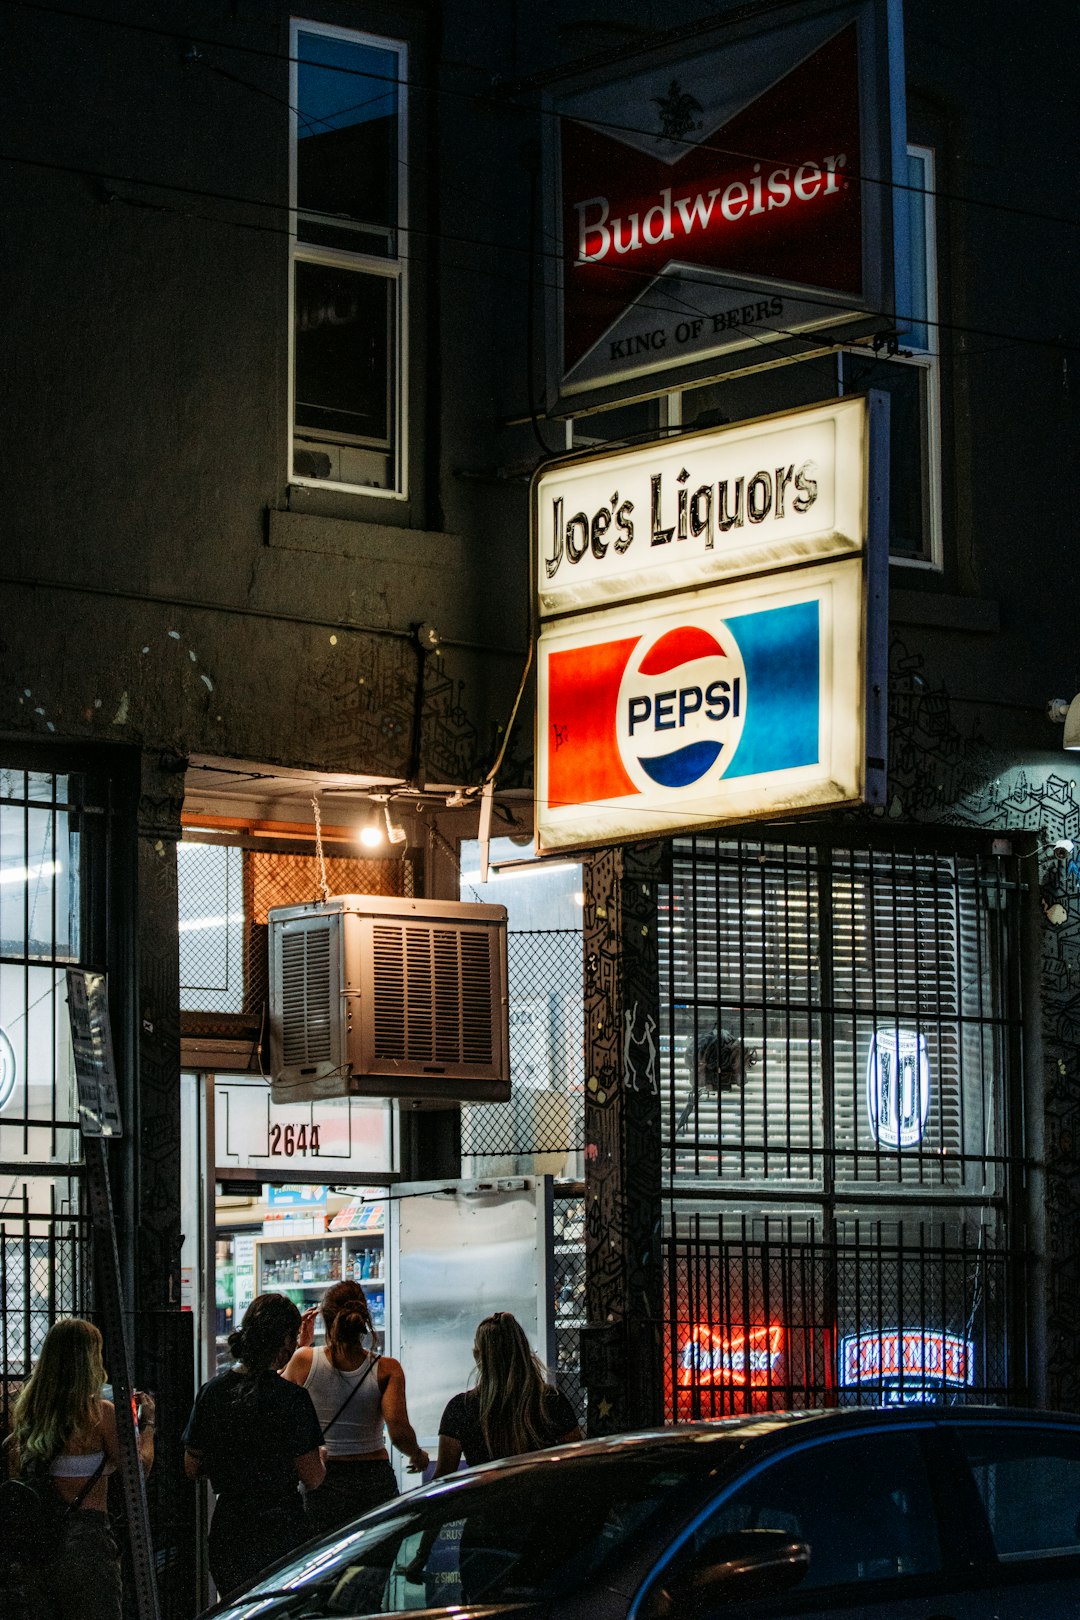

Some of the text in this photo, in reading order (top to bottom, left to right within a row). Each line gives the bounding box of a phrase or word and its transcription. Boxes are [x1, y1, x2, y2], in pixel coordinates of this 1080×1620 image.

[573, 152, 848, 267] Budweiser
[610, 296, 784, 361] KING OF BEERS
[544, 458, 818, 579] Joe's Liquors
[627, 677, 741, 737] PEPSI
[270, 1123, 321, 1158] 2644
